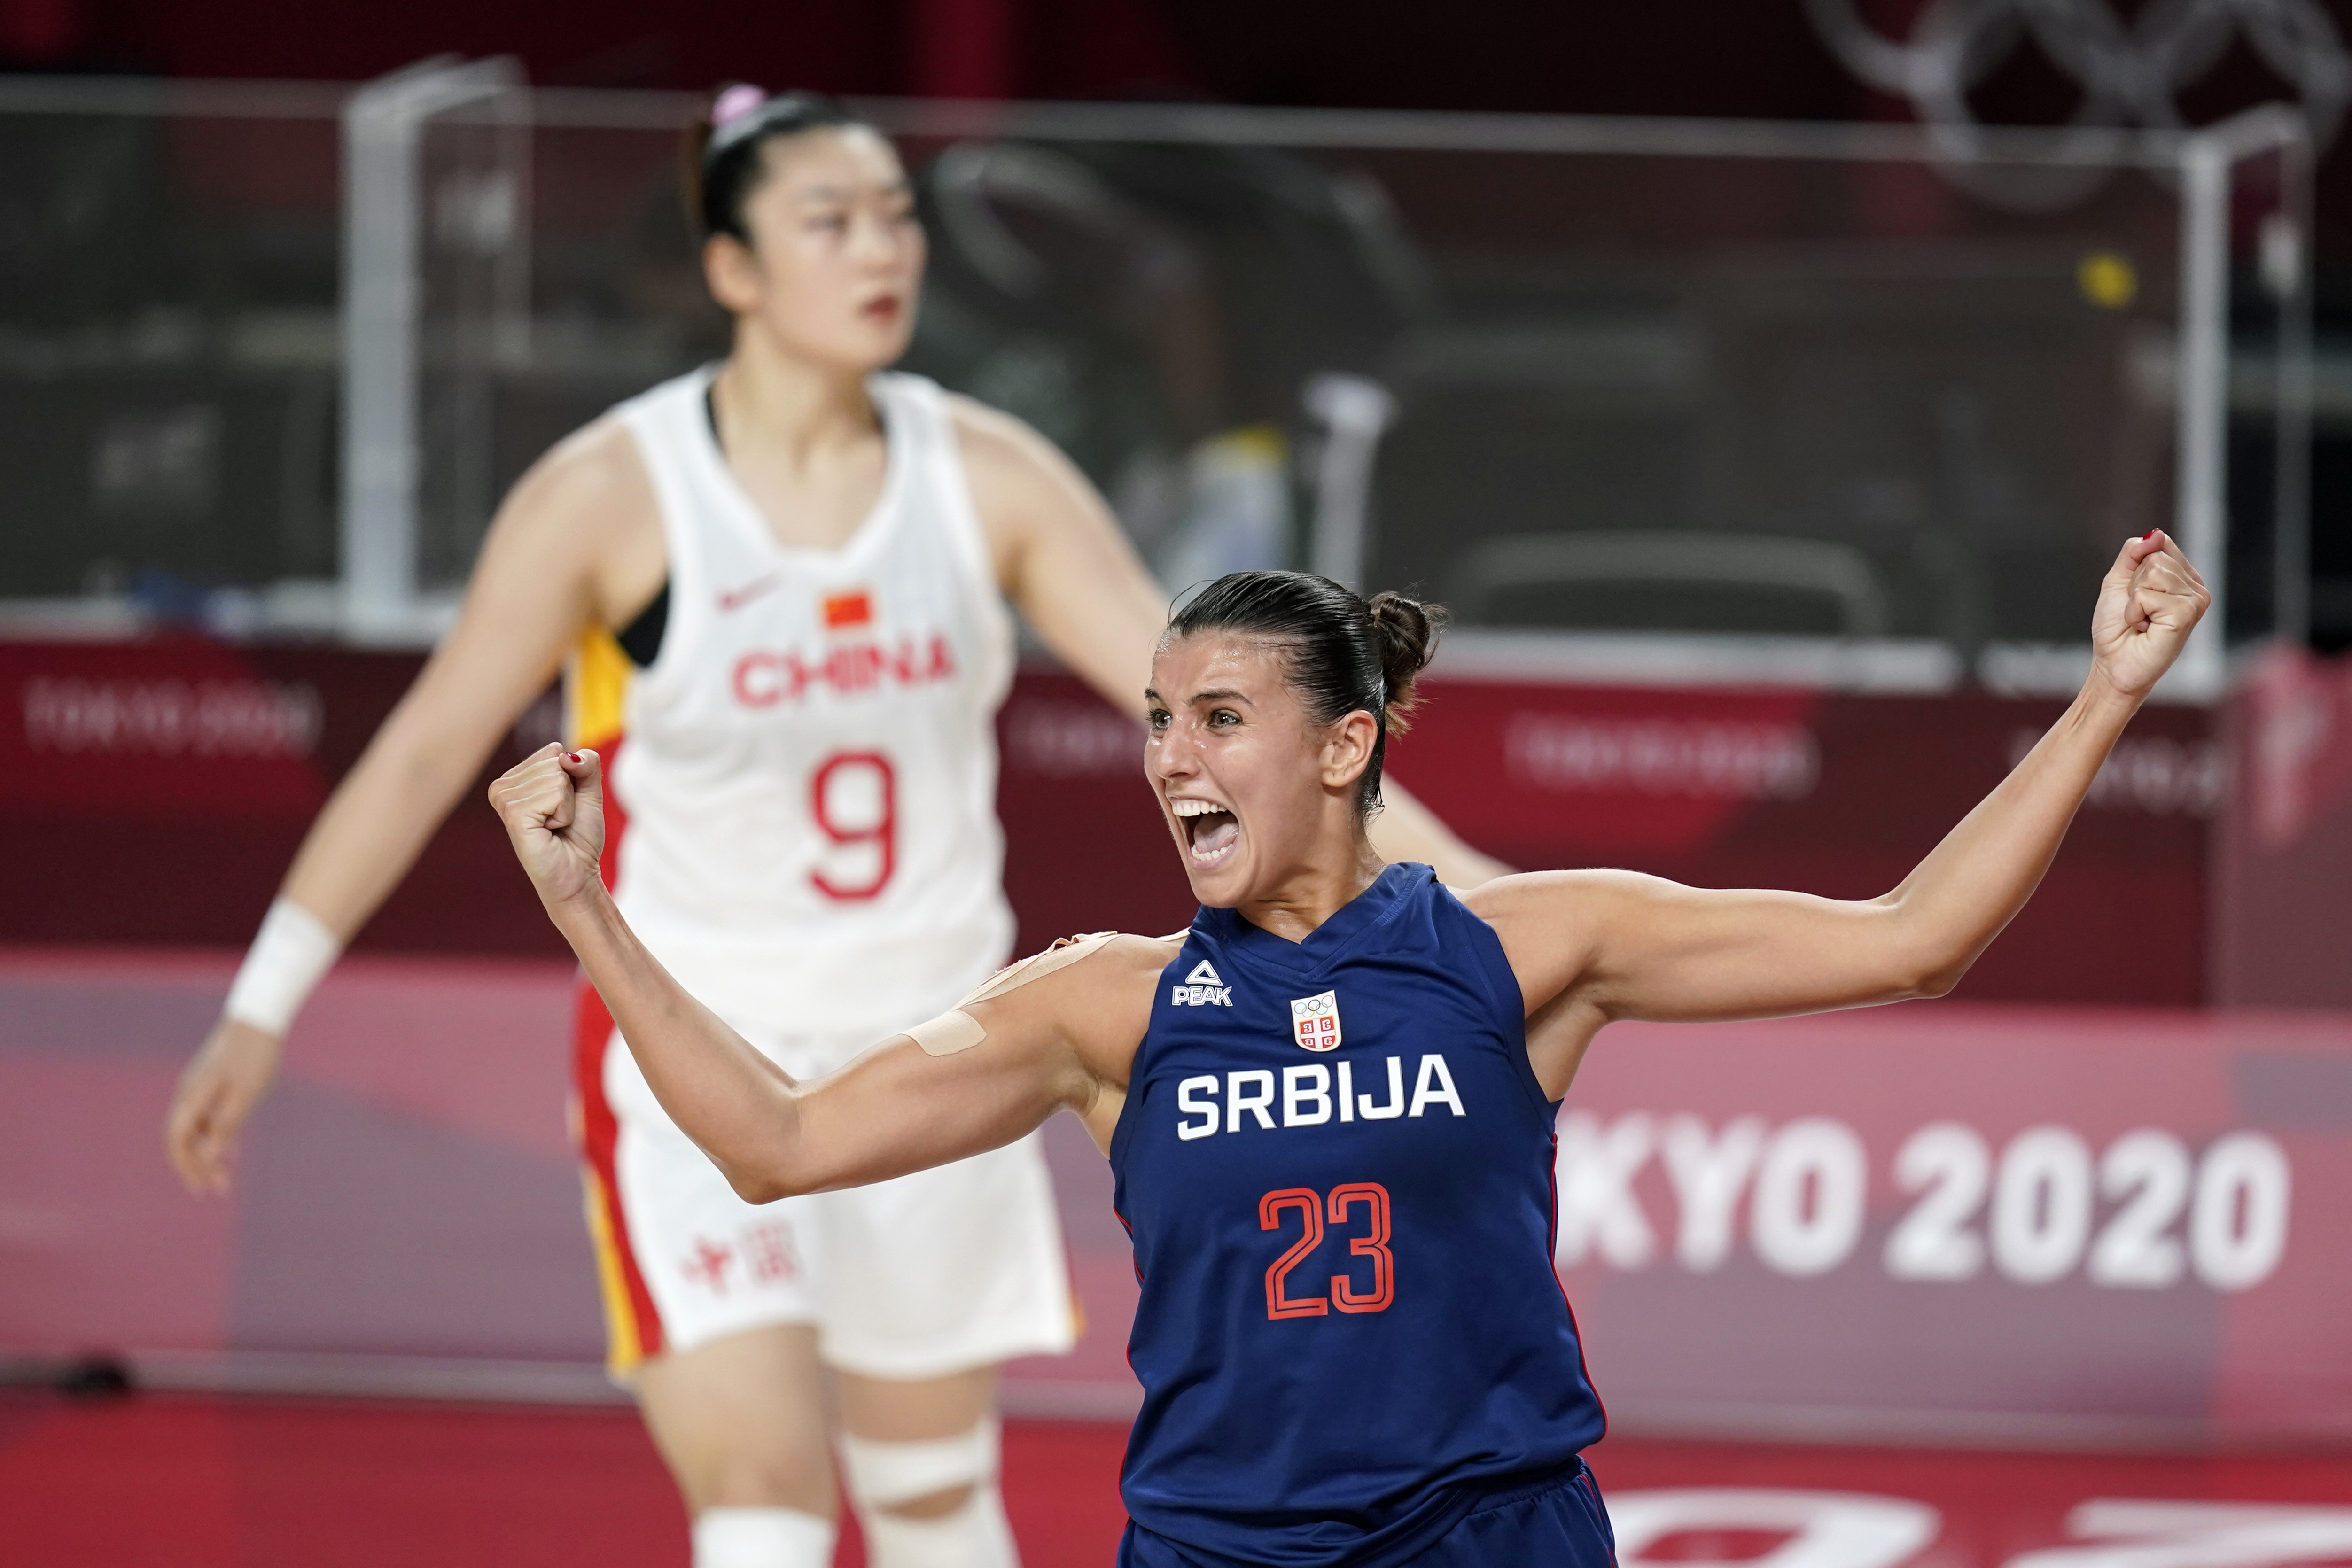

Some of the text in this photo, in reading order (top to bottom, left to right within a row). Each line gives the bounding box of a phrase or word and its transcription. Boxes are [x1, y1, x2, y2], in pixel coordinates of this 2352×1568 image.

[731, 630, 957, 711] CHINA
[809, 747, 898, 904] 9
[1172, 986, 1233, 1007] PEAK
[1177, 1054, 1467, 1141] SRBIJA
[1259, 1182, 1394, 1320] 23
[1554, 1110, 2291, 1291] KYO 2020
